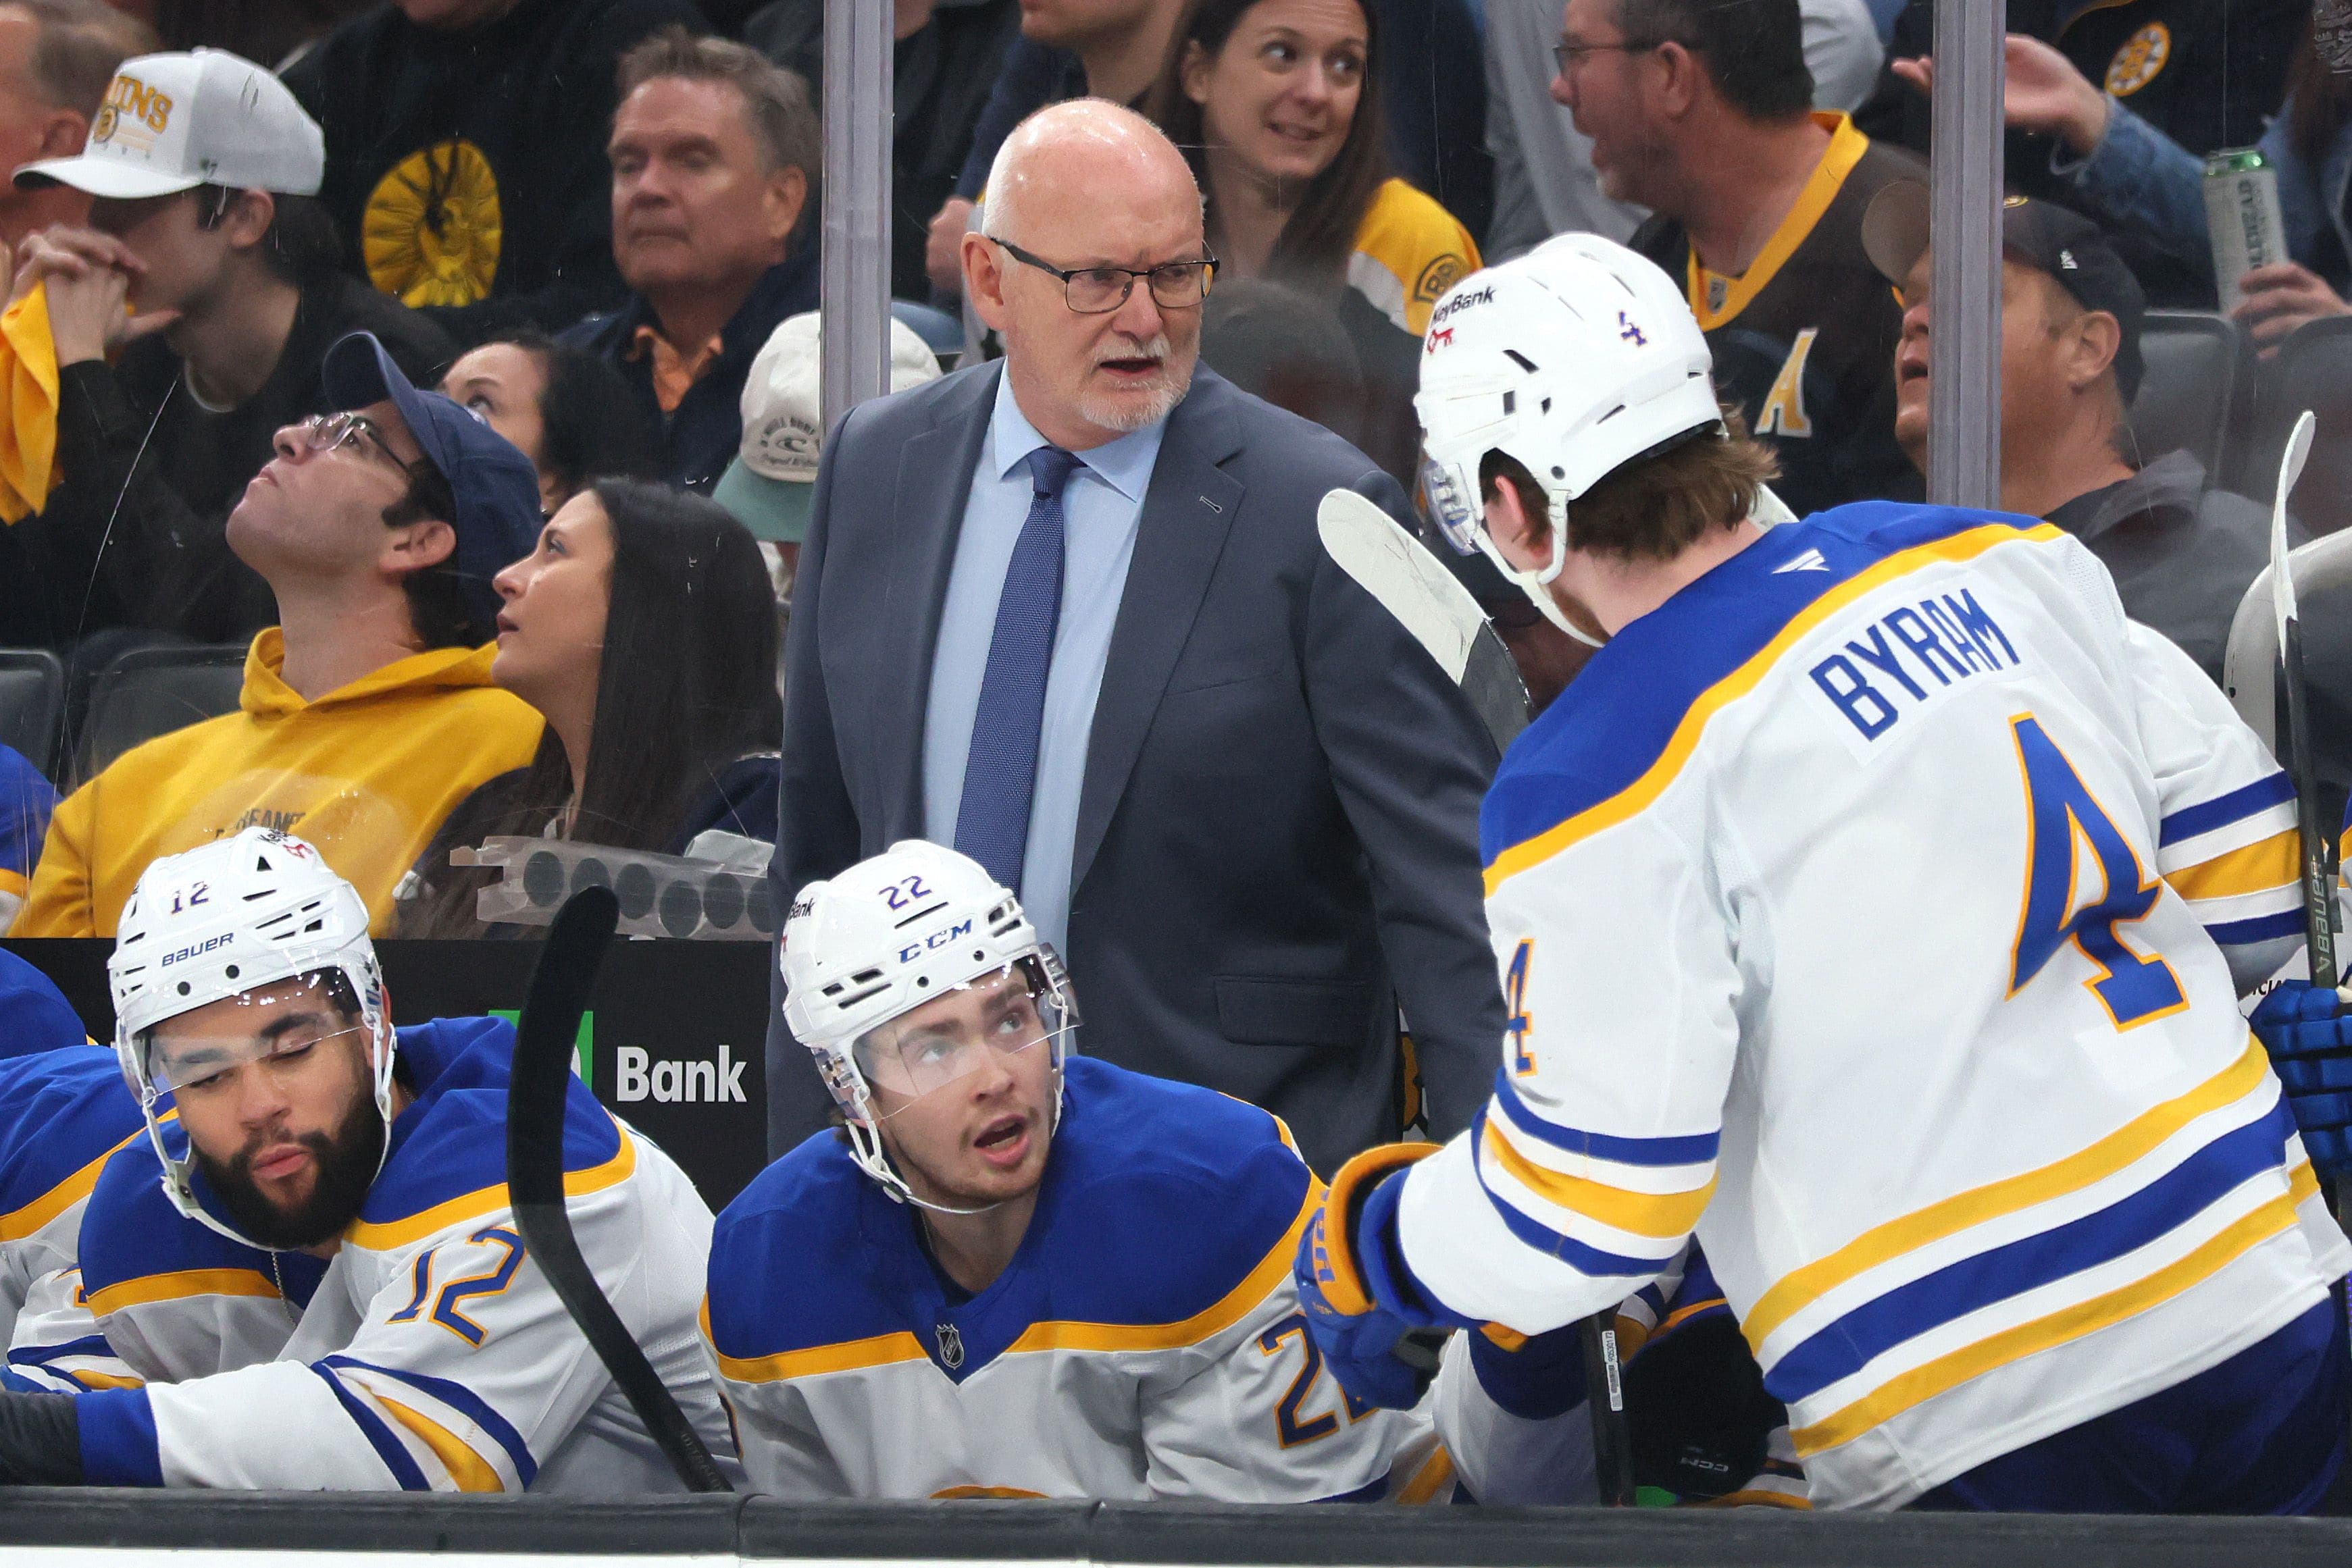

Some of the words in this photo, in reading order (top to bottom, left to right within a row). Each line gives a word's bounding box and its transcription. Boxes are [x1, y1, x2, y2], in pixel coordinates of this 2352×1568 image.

[1619, 311, 1647, 348] 4
[1754, 328, 1819, 438] A
[1808, 588, 2020, 742] BYRAM
[170, 881, 209, 914] 12
[878, 876, 933, 910] 22
[2005, 711, 2190, 1034] 4
[898, 919, 972, 964] CCM
[616, 1045, 748, 1103] Bank
[384, 1225, 530, 1349] 12
